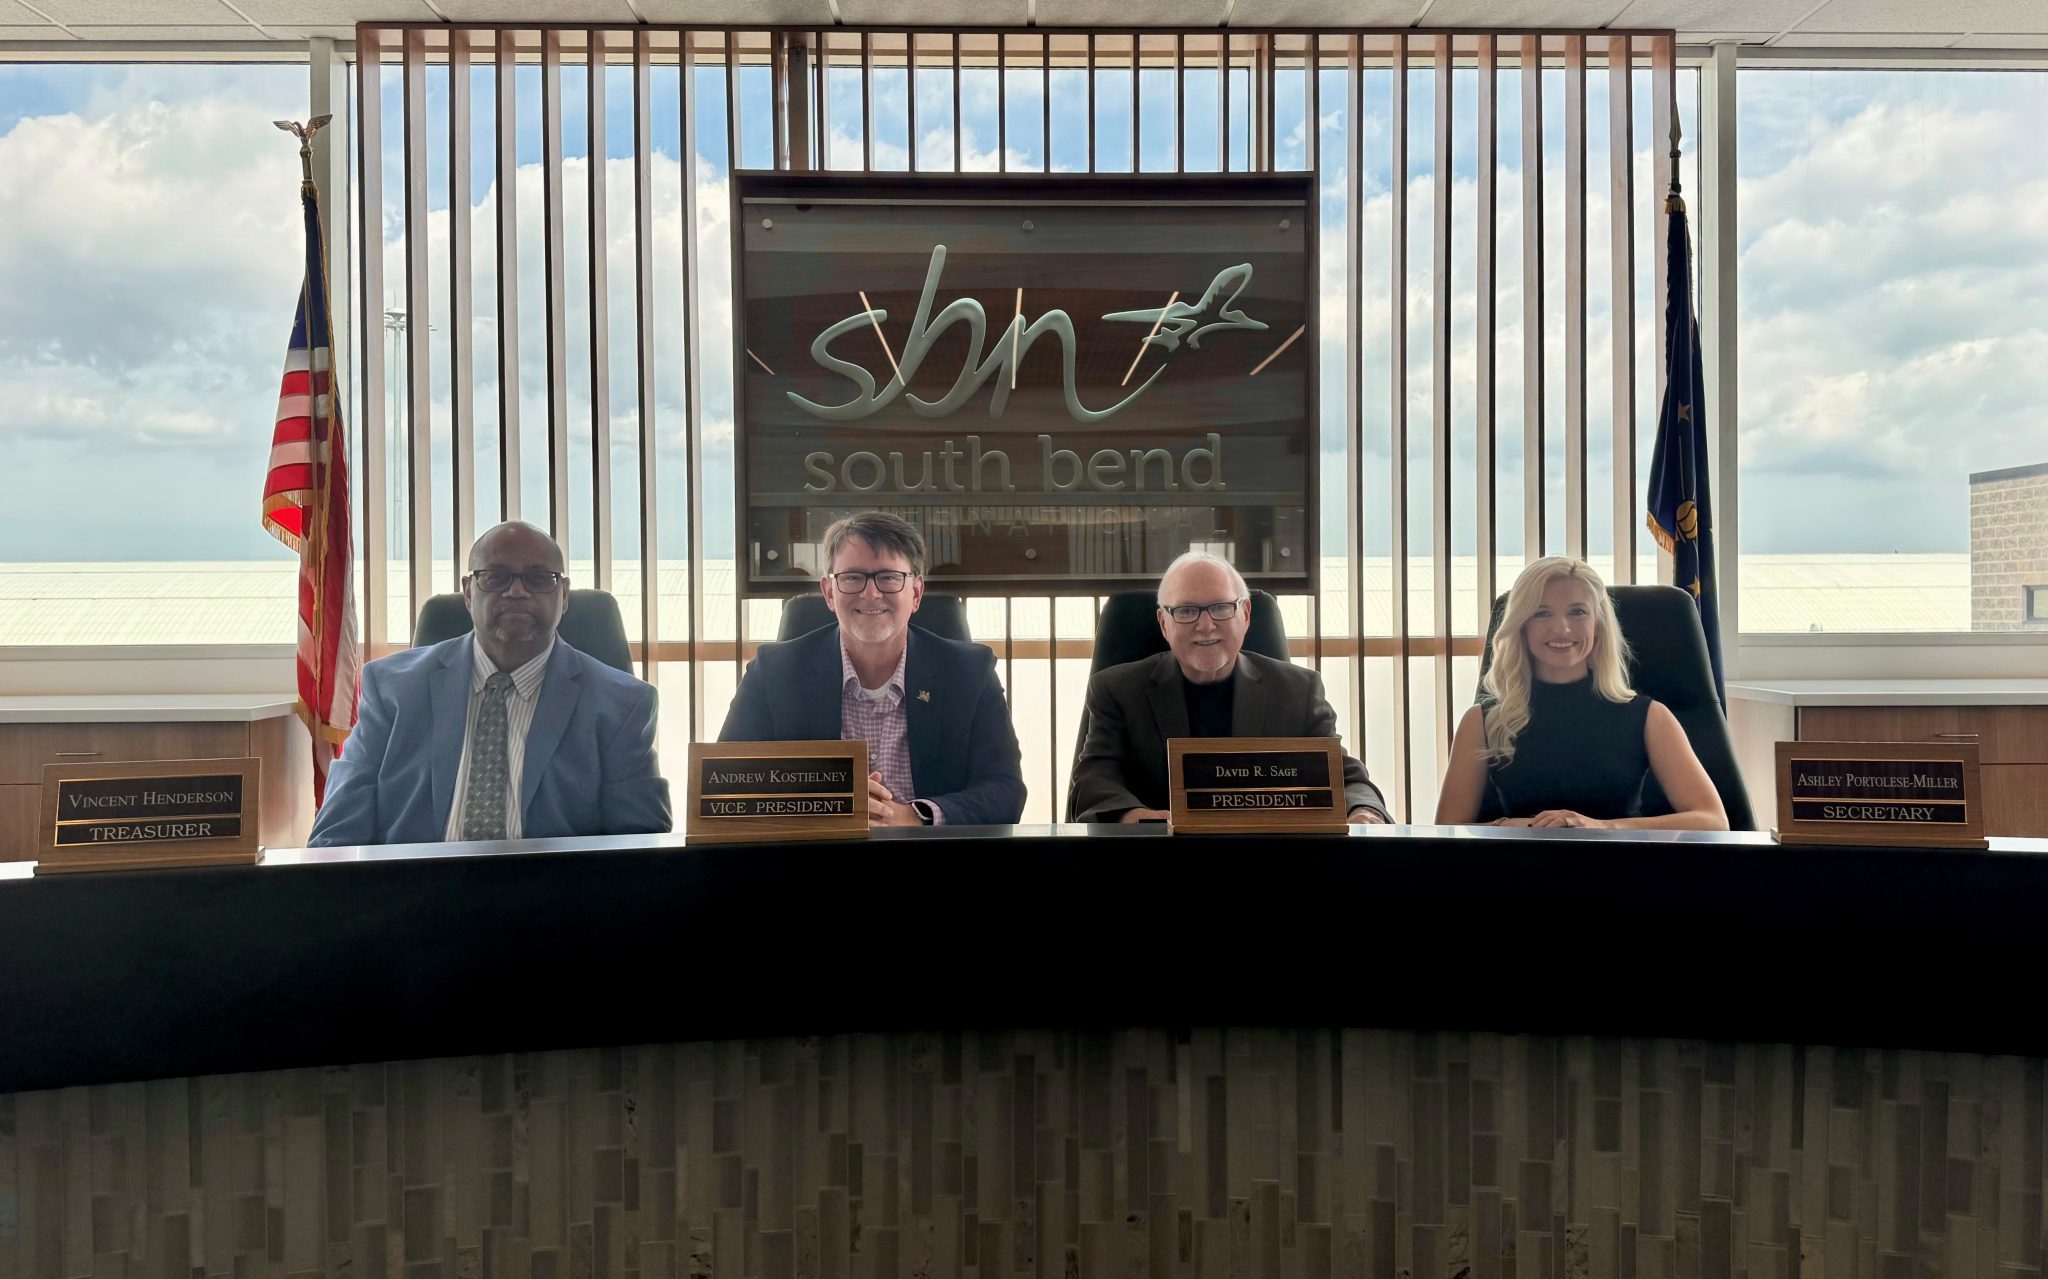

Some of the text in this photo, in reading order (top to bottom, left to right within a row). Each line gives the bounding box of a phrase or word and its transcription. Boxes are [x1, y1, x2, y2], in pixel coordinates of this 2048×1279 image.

[803, 433, 1226, 493] south bend
[1254, 766, 1267, 777] R.
[710, 800, 845, 815] VICE PRESIDENT
[1212, 794, 1307, 807] PRESIDENT
[1823, 805, 1935, 821] SECRETARY
[89, 822, 212, 841] TREASURER
